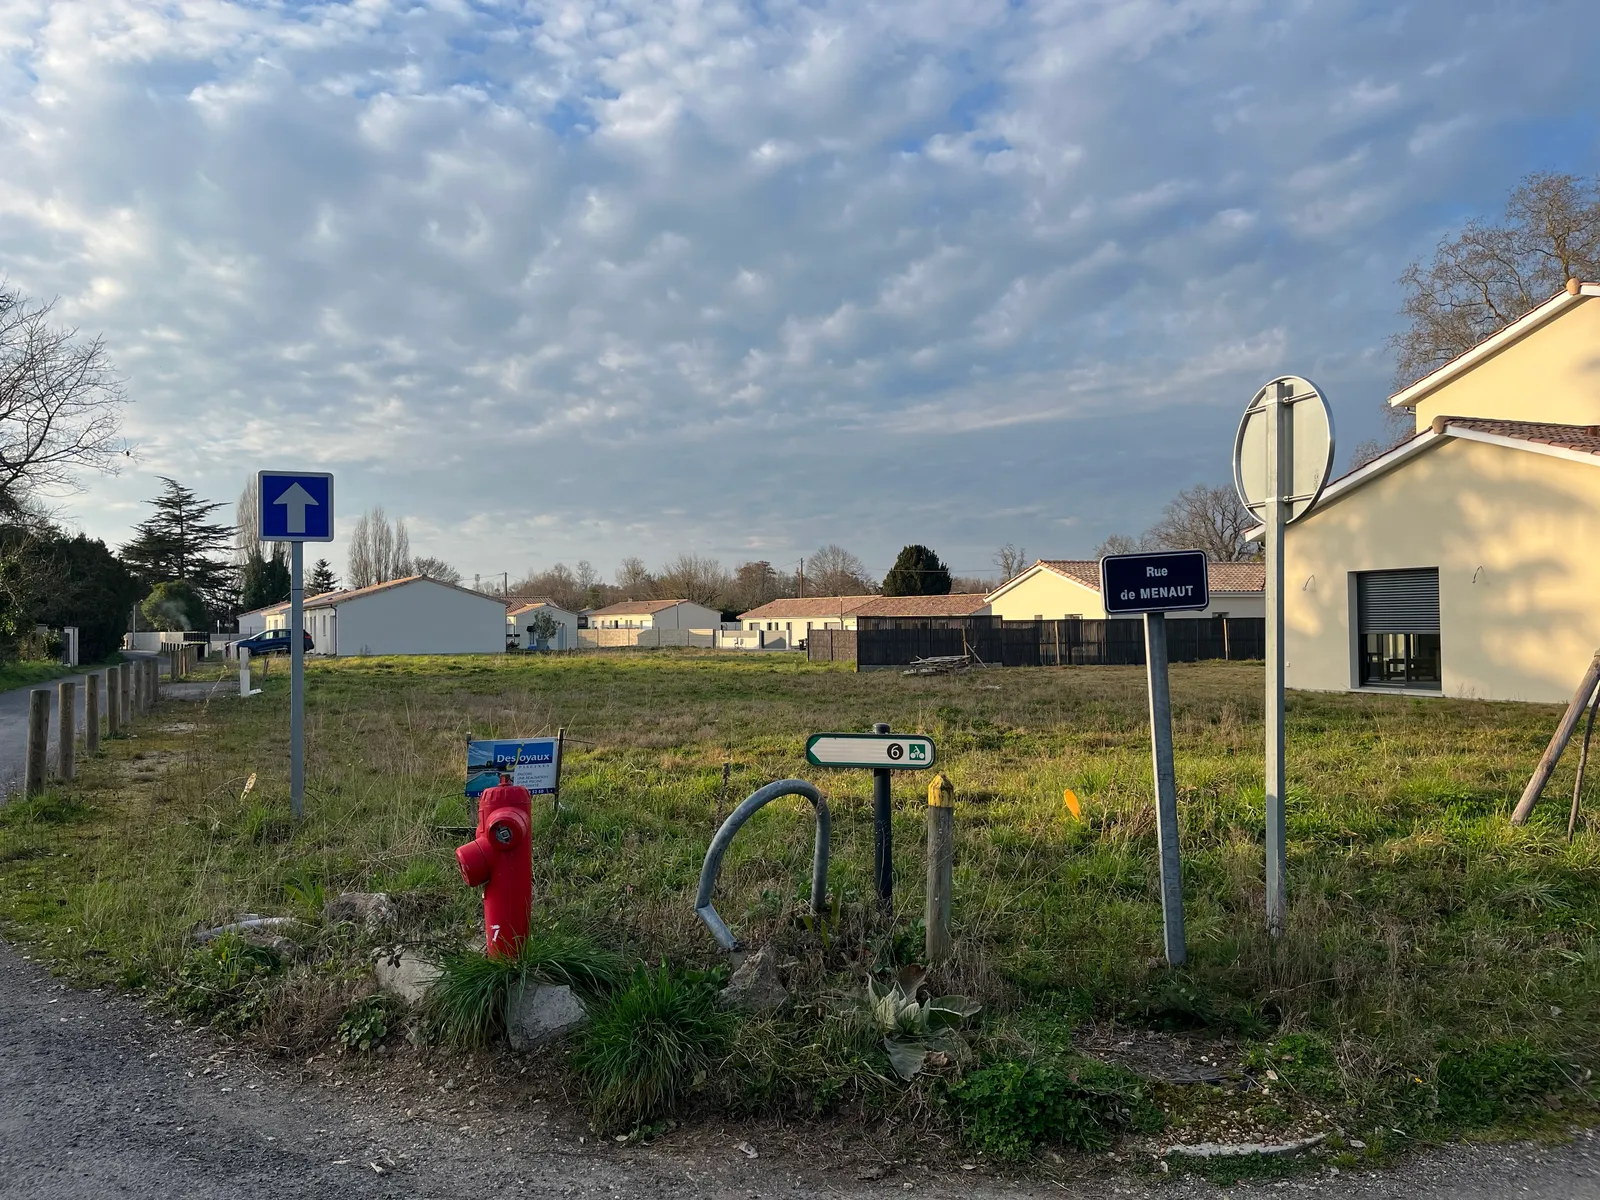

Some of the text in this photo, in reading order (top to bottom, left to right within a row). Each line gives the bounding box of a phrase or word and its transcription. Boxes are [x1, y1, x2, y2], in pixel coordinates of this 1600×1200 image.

[1146, 566, 1168, 577] Rue
[1120, 585, 1194, 600] de MENAUT
[890, 745, 900, 758] 6
